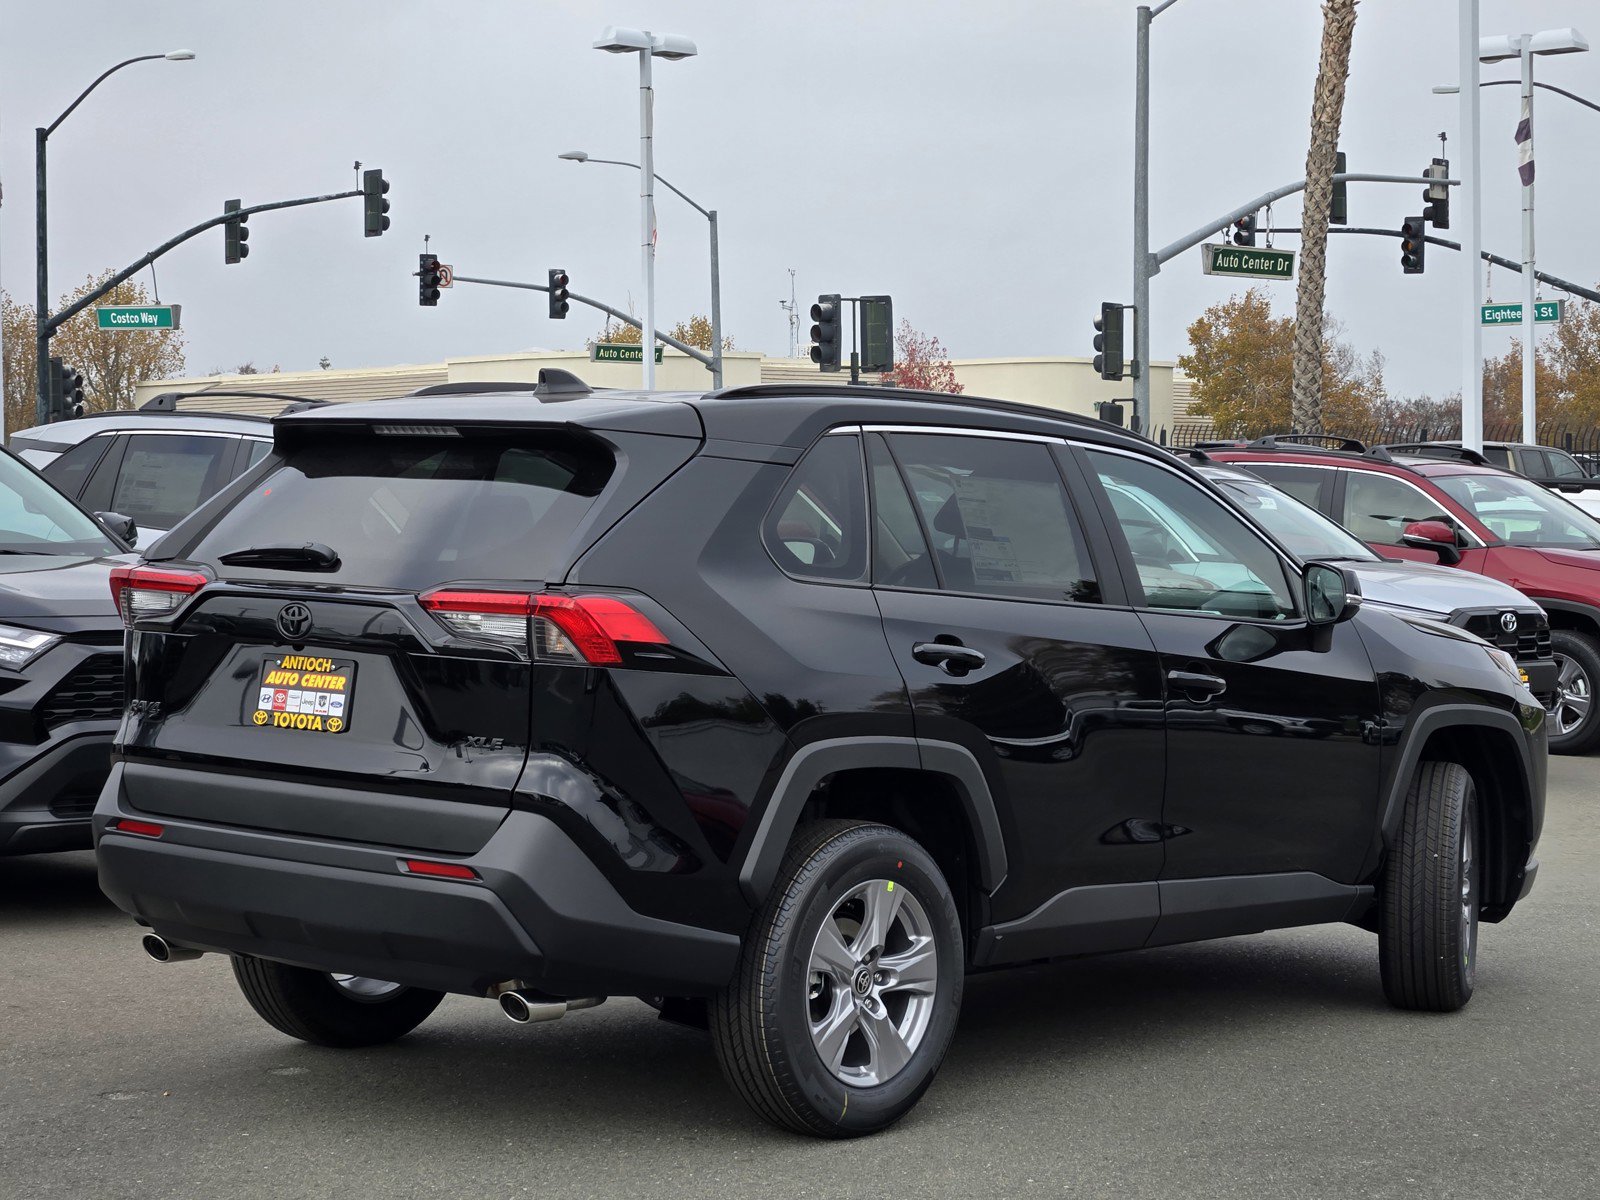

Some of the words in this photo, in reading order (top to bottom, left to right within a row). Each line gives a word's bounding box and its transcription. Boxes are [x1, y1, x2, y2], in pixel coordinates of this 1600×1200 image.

[1216, 253, 1239, 268] Auto
[1242, 255, 1274, 271] Center
[1277, 258, 1289, 271] Dr
[110, 312, 140, 324] Costco
[140, 312, 158, 326] Way
[1484, 308, 1539, 322] Eightee
[1541, 306, 1553, 317] St
[598, 348, 618, 358] Auto
[620, 349, 643, 359] Cente
[281, 655, 332, 673] ANTIOCH
[265, 670, 299, 687] AUTO
[301, 673, 347, 690] CENTER
[273, 711, 323, 731] TOYOTA
[464, 735, 504, 749] XLE
